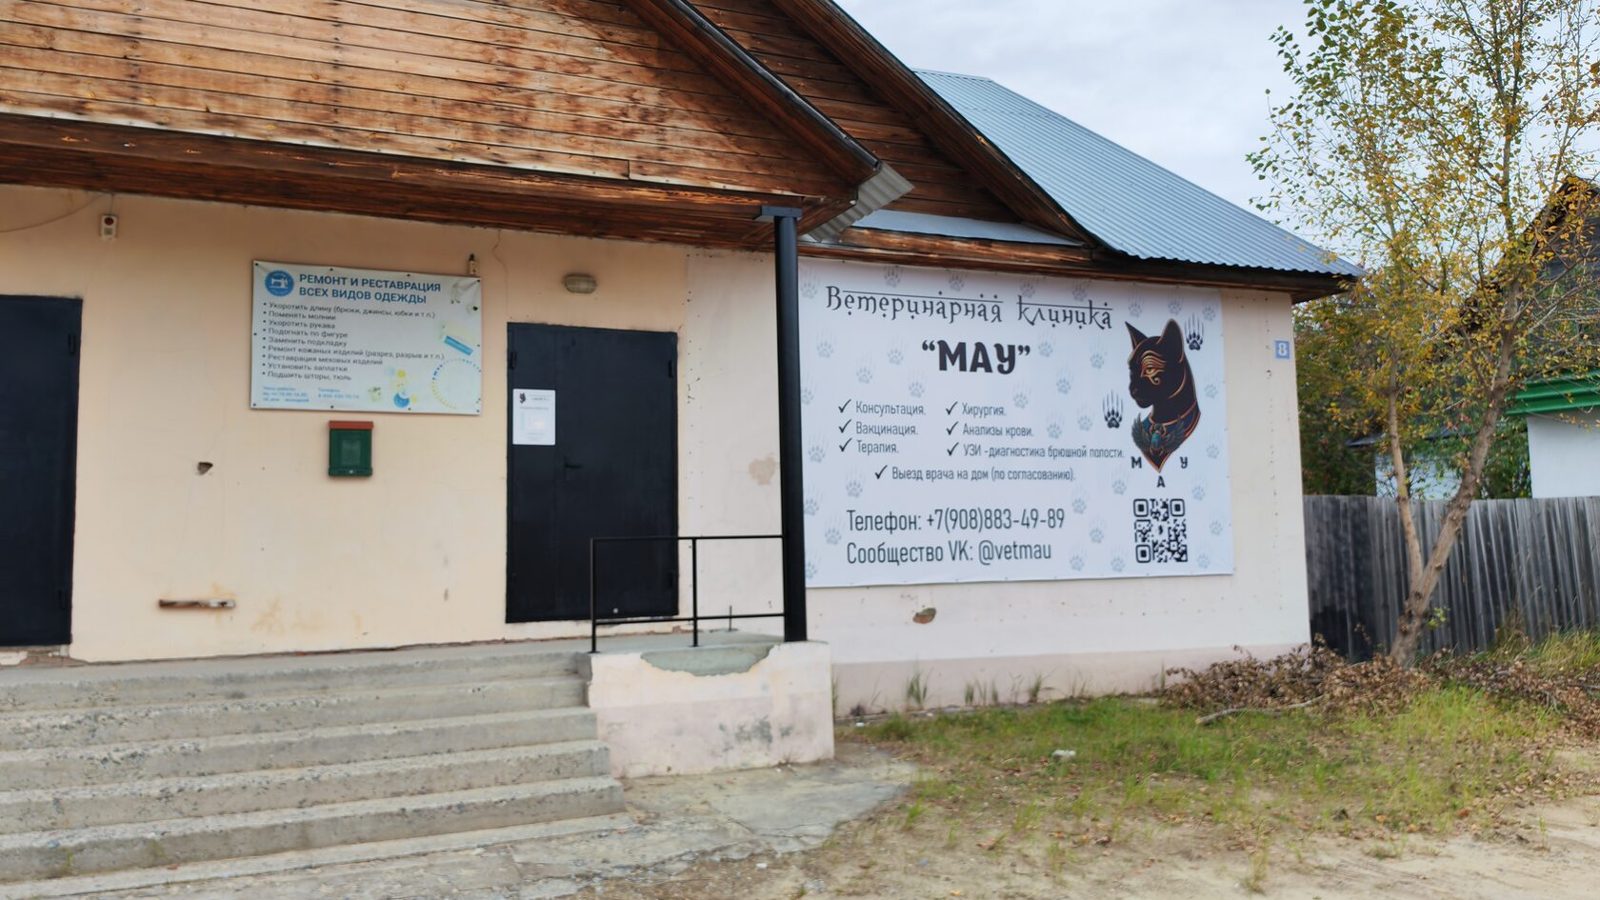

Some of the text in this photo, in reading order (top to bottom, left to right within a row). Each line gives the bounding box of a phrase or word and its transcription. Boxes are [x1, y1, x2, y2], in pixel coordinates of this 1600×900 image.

[299, 274, 346, 286] РЕМОНТ
[350, 278, 358, 286] И
[362, 279, 441, 292] РЕСТАВРАЦИЯ
[299, 287, 328, 297] ВСЕХ
[332, 289, 371, 300] ВИДОВ
[374, 292, 426, 304] ОДЕЖДЫ
[268, 302, 308, 310] Укоротить
[826, 285, 1003, 324] Ветеринарная
[268, 310, 306, 319] Поменять
[268, 319, 308, 328] Укоротить
[1278, 342, 1288, 356] 8
[856, 401, 926, 416] Консультация.
[962, 403, 1006, 418] Хирургия.
[856, 421, 918, 436] Вакцинация.
[962, 423, 1034, 438] Анализы крови.
[856, 440, 900, 456] Терапия.
[963, 444, 982, 456] УЗИ
[1048, 445, 1087, 458] брюшной
[1089, 448, 1125, 458] полости.
[892, 466, 923, 480] Выезд
[926, 469, 955, 482] врача
[956, 470, 969, 480] на
[971, 469, 989, 481] дом
[991, 466, 1006, 482] (по
[846, 507, 1065, 534] Телефон: +7(908)883-49-89
[846, 539, 1052, 566] Сообщество VK: @vetmau
